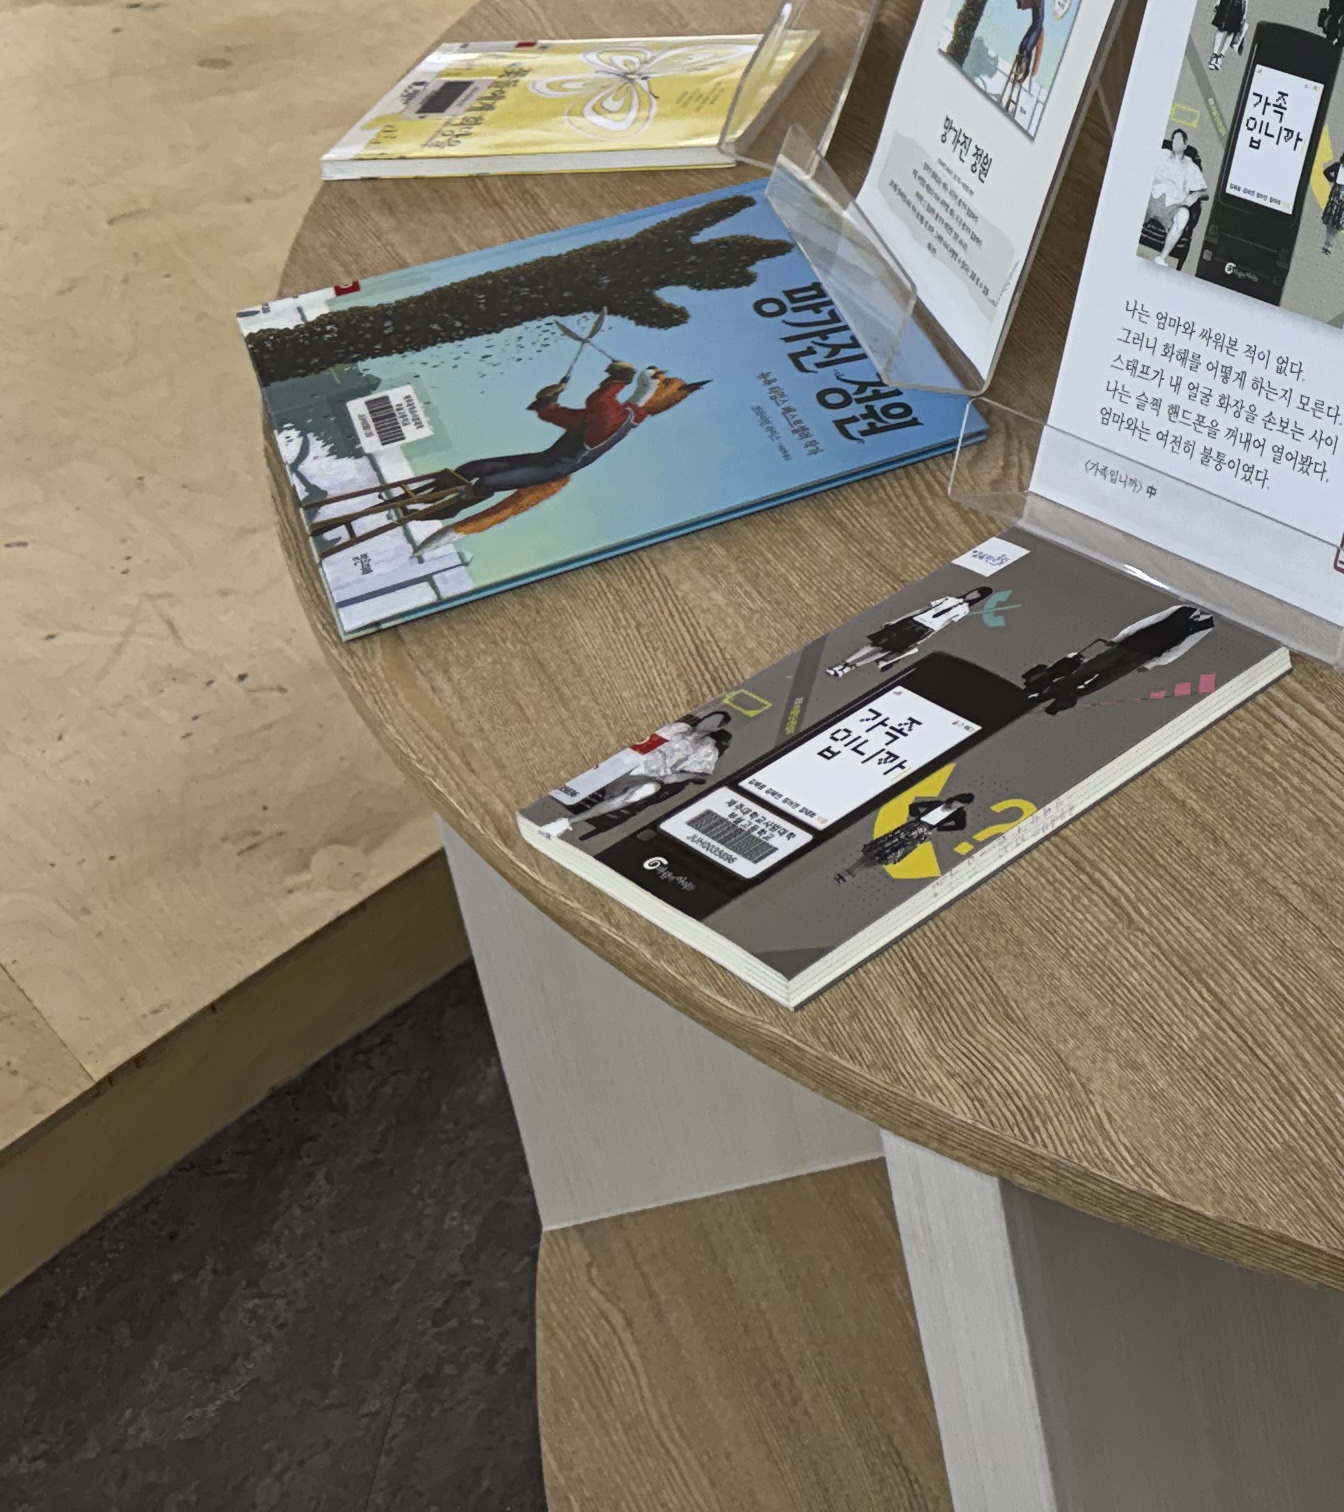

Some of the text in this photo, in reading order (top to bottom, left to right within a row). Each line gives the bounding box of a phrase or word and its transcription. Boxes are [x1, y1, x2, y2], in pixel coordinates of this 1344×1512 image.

[1245, 116, 1303, 151] 입니까
[1252, 90, 1288, 123] 가족
[940, 115, 992, 183] 망가진 정원
[752, 282, 925, 444] 망가진 정원
[1116, 327, 1342, 425] 그러니 화해를 어떻게 하는지 모른다.
[1125, 299, 1304, 381] 나는 엄마와 싸워본 적이 없다.
[1105, 379, 1328, 482] 나는 슬쩍 핸드폰을 꺼내어 열어봤다.
[1110, 354, 1338, 455] 스태프가 내 얼굴 화장을 손보는 사이
[1099, 406, 1269, 489] 엄마와는 여전히 불통이였다.
[816, 727, 907, 775] 입니까
[859, 708, 922, 746] 가족
